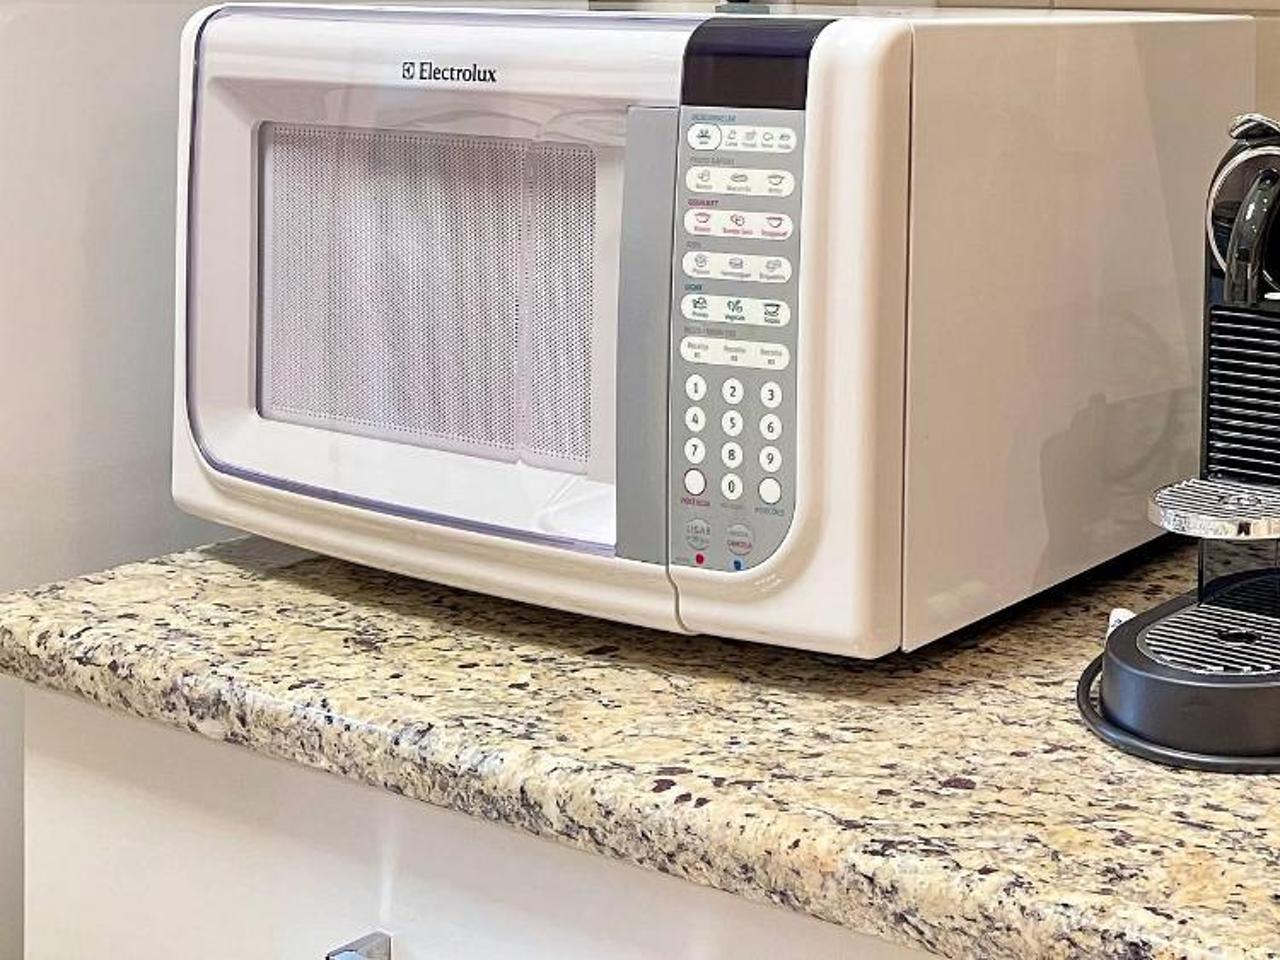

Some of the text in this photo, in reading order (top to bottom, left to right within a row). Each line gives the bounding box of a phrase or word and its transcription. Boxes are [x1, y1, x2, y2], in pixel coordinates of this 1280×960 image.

[419, 61, 497, 83] Electrolux
[693, 383, 699, 394] 1
[729, 385, 737, 397] 2
[767, 389, 774, 401] 3
[692, 413, 699, 424] 4
[729, 417, 736, 430] 5
[767, 421, 774, 434] 6
[691, 444, 698, 456] 7
[728, 449, 736, 461] 8
[767, 453, 774, 465] 9
[728, 480, 735, 493] 0
